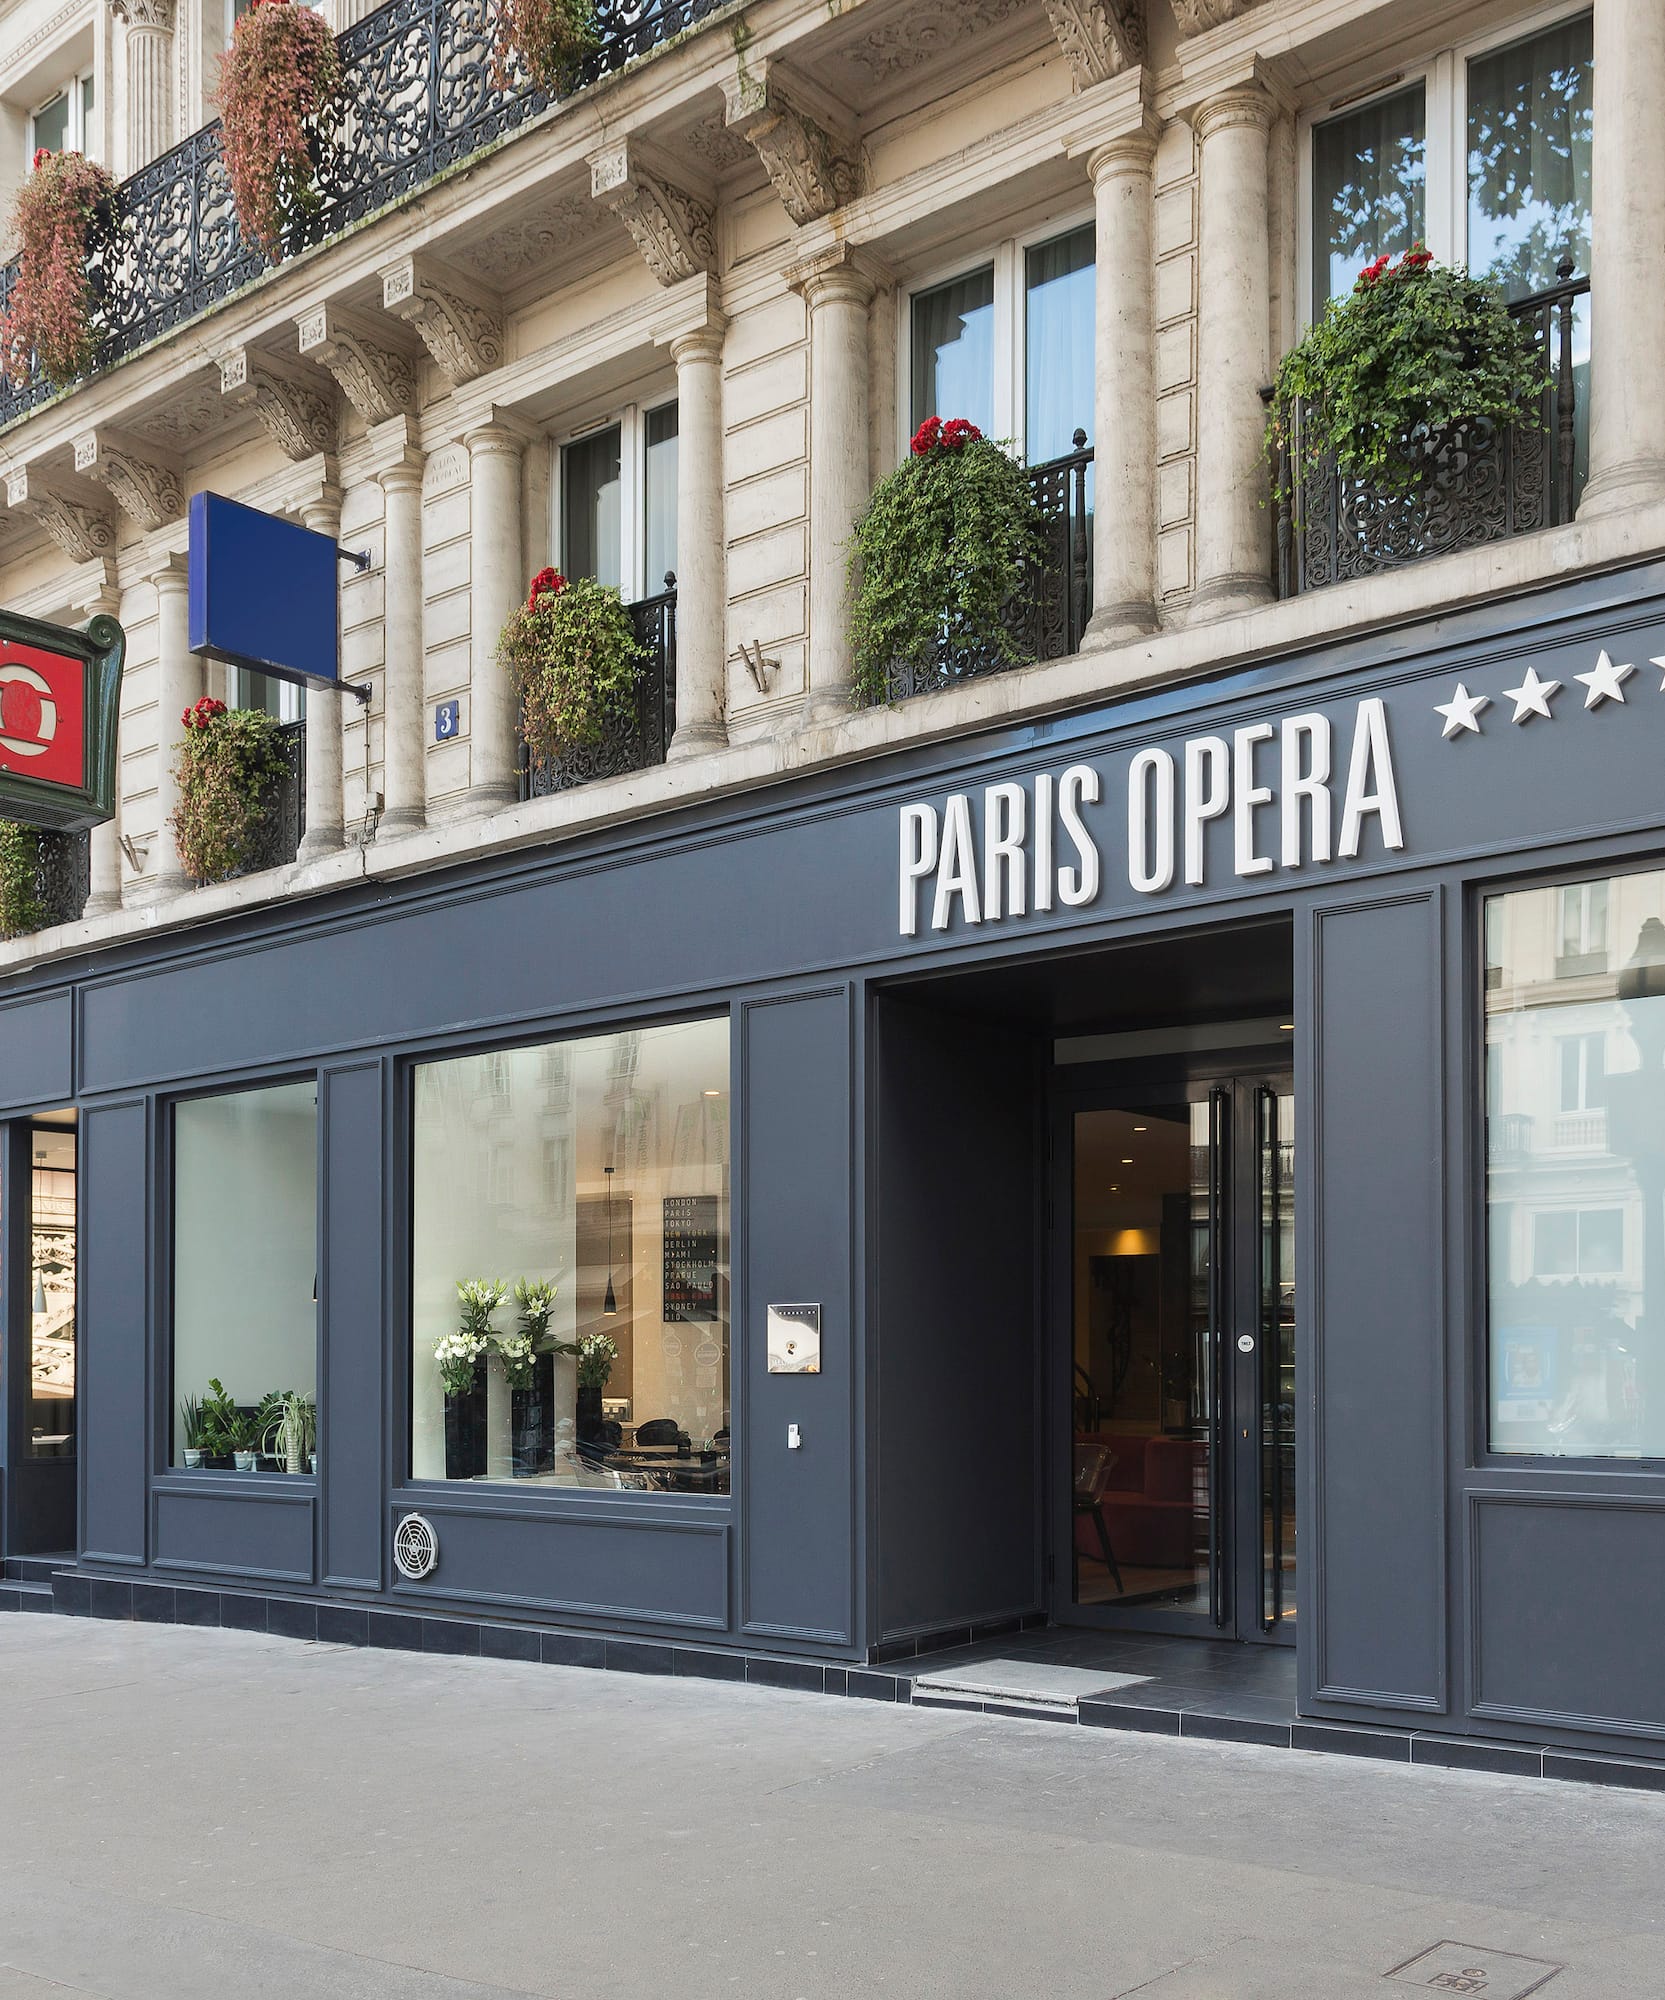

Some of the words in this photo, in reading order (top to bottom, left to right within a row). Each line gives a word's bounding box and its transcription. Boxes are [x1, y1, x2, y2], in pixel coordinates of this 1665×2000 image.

[440, 707, 452, 734] 3
[899, 764, 1100, 936] PARIS
[1127, 697, 1404, 894] OPERA
[665, 1198, 697, 1207] LONDON
[665, 1209, 691, 1217] PARIS
[665, 1219, 691, 1228] TOKYO
[665, 1240, 697, 1249] BERLIN
[665, 1260, 714, 1269] STOCKHOLM
[665, 1271, 697, 1279] PRAGUE
[687, 1280, 714, 1289] PAULO
[665, 1303, 697, 1311] SYDNEY
[665, 1312, 681, 1321] RIO
